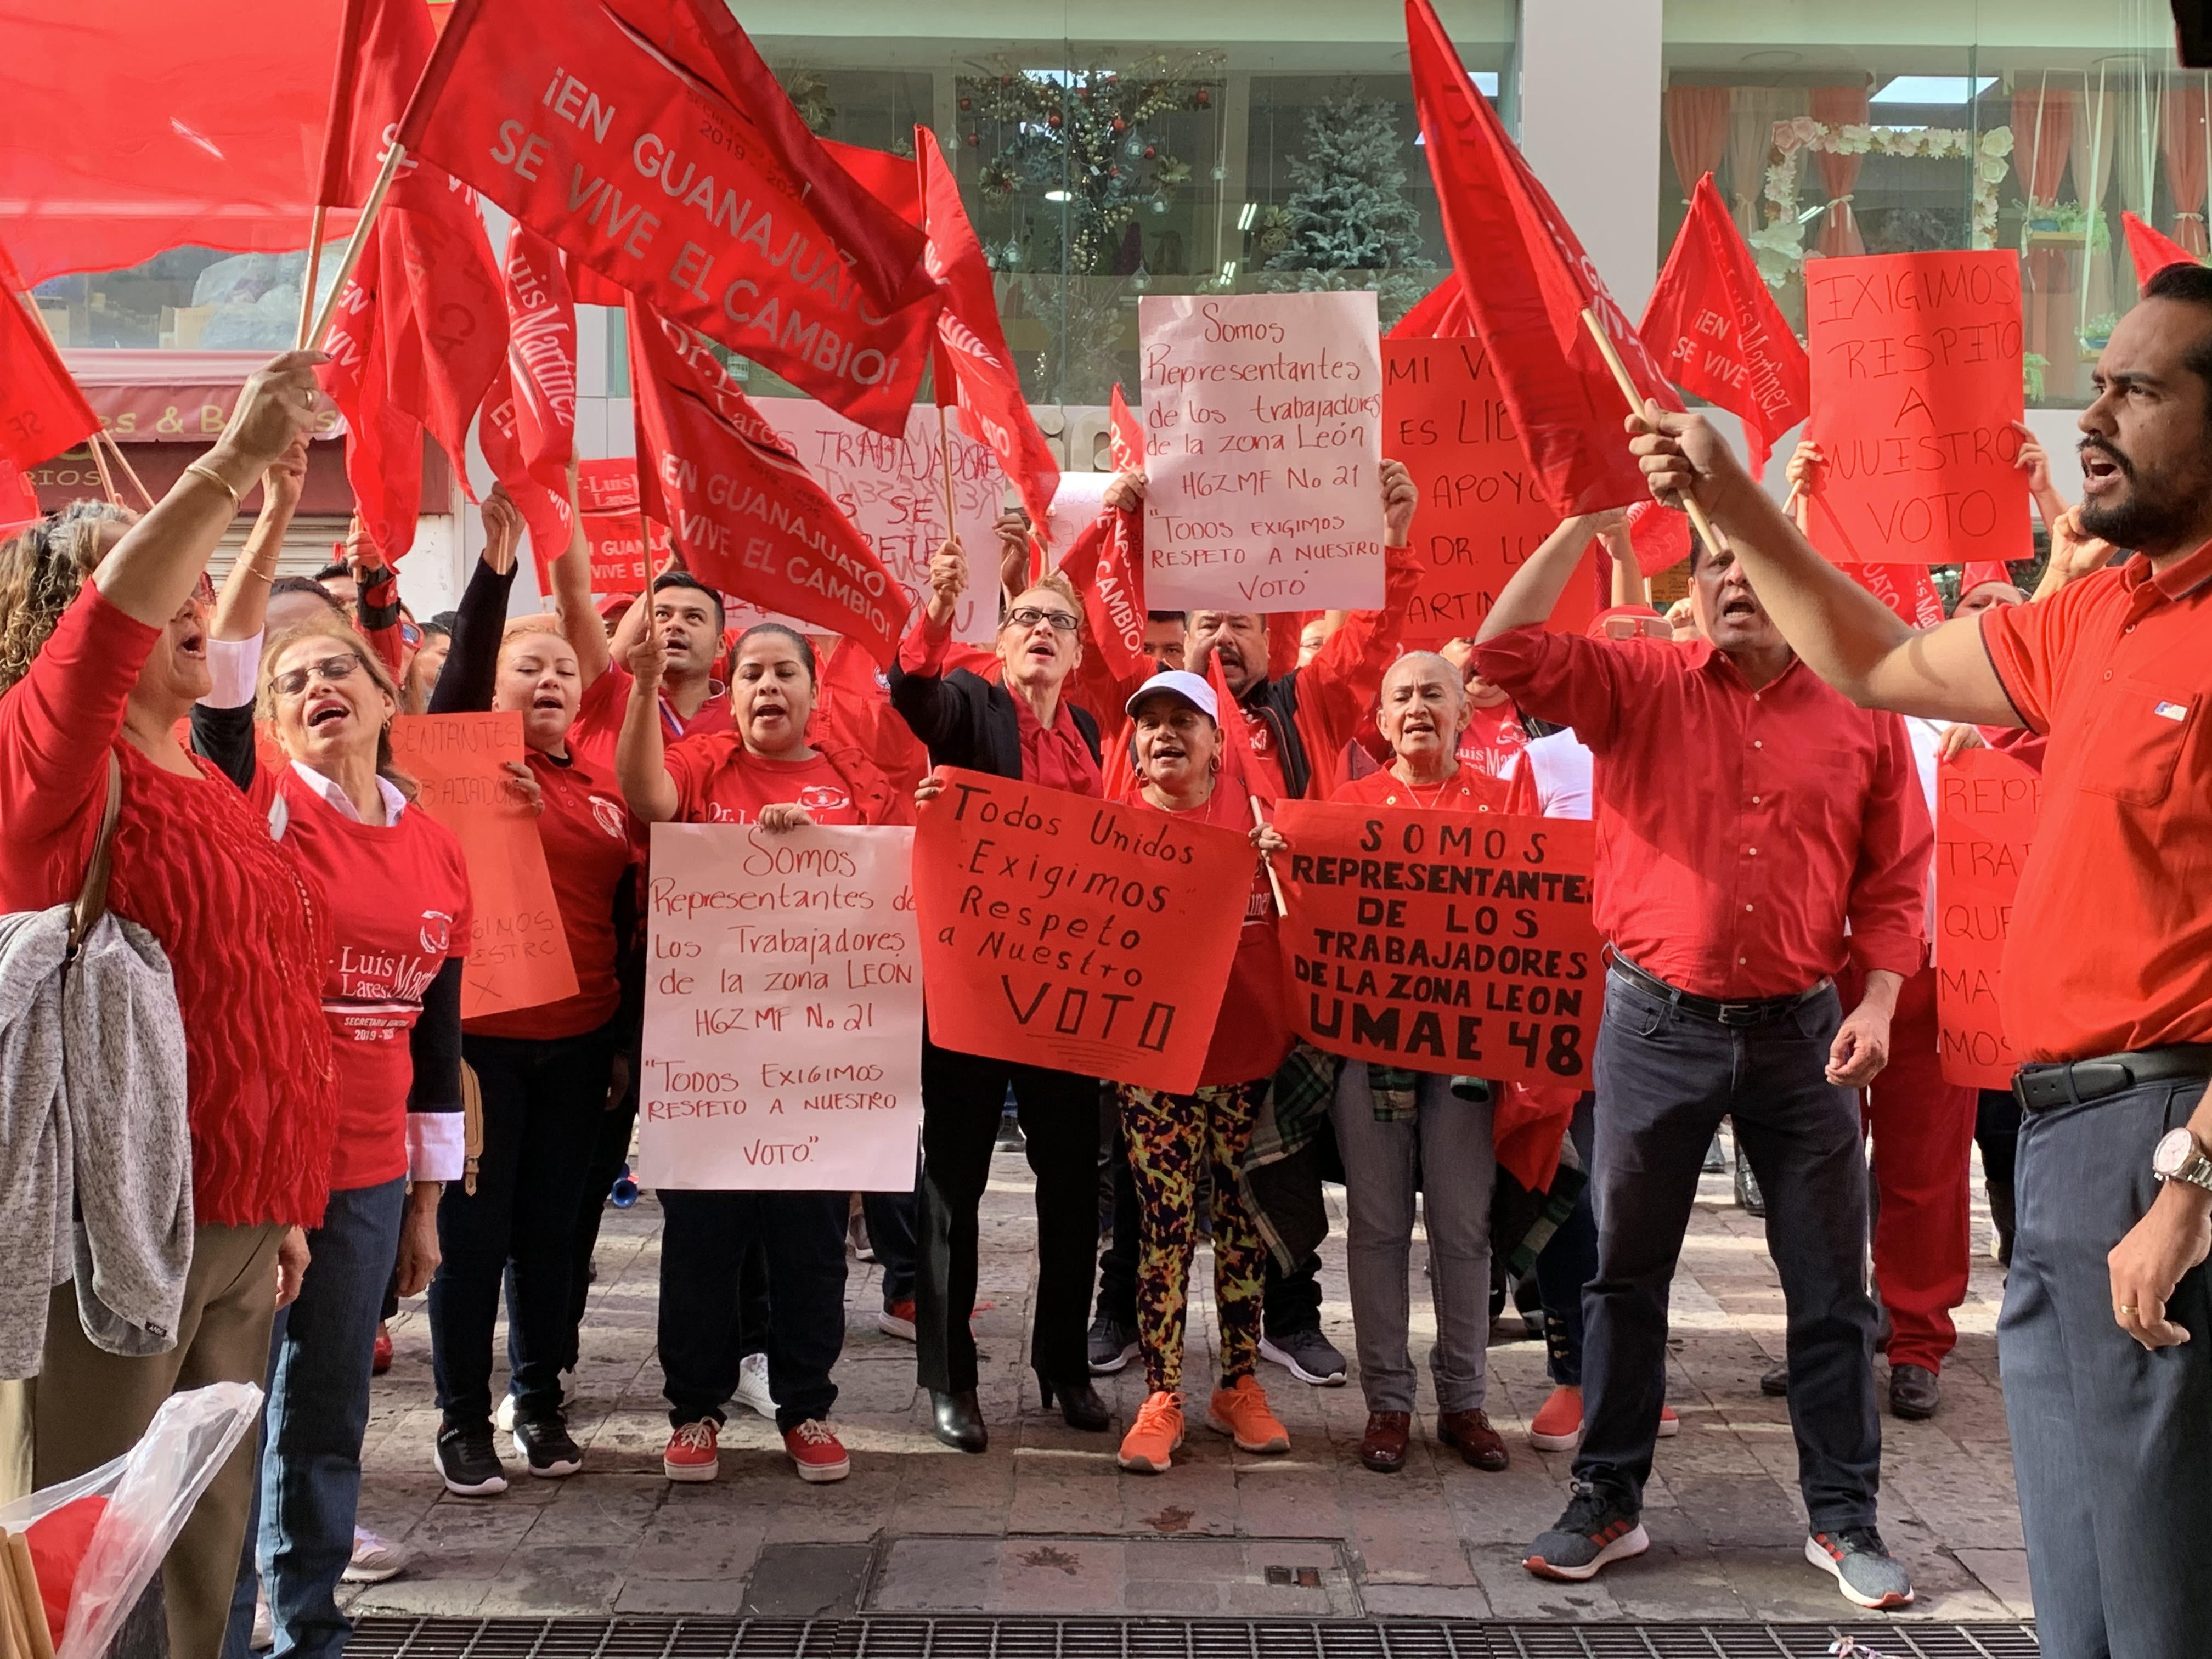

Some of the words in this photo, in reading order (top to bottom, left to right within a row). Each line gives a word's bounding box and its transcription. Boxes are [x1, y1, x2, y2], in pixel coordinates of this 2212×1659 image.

[490, 119, 552, 182] SE
[568, 163, 661, 260] VIVE
[669, 241, 714, 303] EL
[725, 280, 899, 394] CAMBIO!
[1814, 265, 2015, 325] EXIGIMOS
[1203, 303, 1284, 343] Somos
[1147, 342, 1361, 392] Representantes
[1389, 357, 1429, 386] MI
[1672, 337, 1698, 364] SE
[1703, 351, 1749, 390] VIVE
[156, 405, 184, 434] &
[1149, 402, 1176, 428] de
[1250, 393, 1381, 426] trabajadores
[1894, 386, 1936, 427] A
[1147, 433, 1170, 456] de
[1184, 435, 1203, 454] la
[1219, 433, 1284, 453] zona
[1400, 419, 1437, 447] ES
[1333, 464, 1359, 488] 21
[708, 473, 886, 597] GUANAJUATO
[1251, 516, 1345, 538] EXIGIMOS
[1867, 490, 1997, 544] VOTO
[1152, 549, 1245, 568] RESPETO
[1268, 548, 1282, 564] A
[1296, 541, 1379, 561] NUESTRO
[680, 509, 733, 559] VIVE
[743, 538, 777, 574] EL
[786, 557, 891, 642] CAMBIO!
[955, 783, 1059, 836] Todos
[1091, 809, 1194, 865] Unidos
[1359, 820, 1547, 864] SOMOS
[650, 876, 874, 919] Representantes
[960, 885, 1141, 950] Respeto
[1358, 897, 1407, 928] DE
[1446, 904, 1539, 939] LOS
[338, 946, 395, 977] Luis
[727, 925, 905, 964] Trabajadores
[939, 926, 955, 946] a
[978, 932, 1142, 986] Nuestro
[1314, 928, 1587, 980] TRABAJADORES
[659, 969, 694, 995] de
[721, 969, 742, 992] la
[764, 972, 829, 991] zona
[1294, 955, 1328, 988] DE
[1336, 965, 1377, 996] LA
[1386, 973, 1471, 1008] ZONA
[1486, 981, 1582, 1017] LEON
[844, 1003, 872, 1030] 21
[1001, 975, 1176, 1052] VOTO
[354, 1029, 376, 1041] 2019
[1310, 994, 1483, 1060] UMAE
[1508, 1021, 1583, 1076] 48
[762, 1063, 884, 1088] EXIGIMOS
[648, 1099, 747, 1123] RESPETO
[769, 1099, 784, 1114] A
[804, 1092, 896, 1111] NUESTRO
